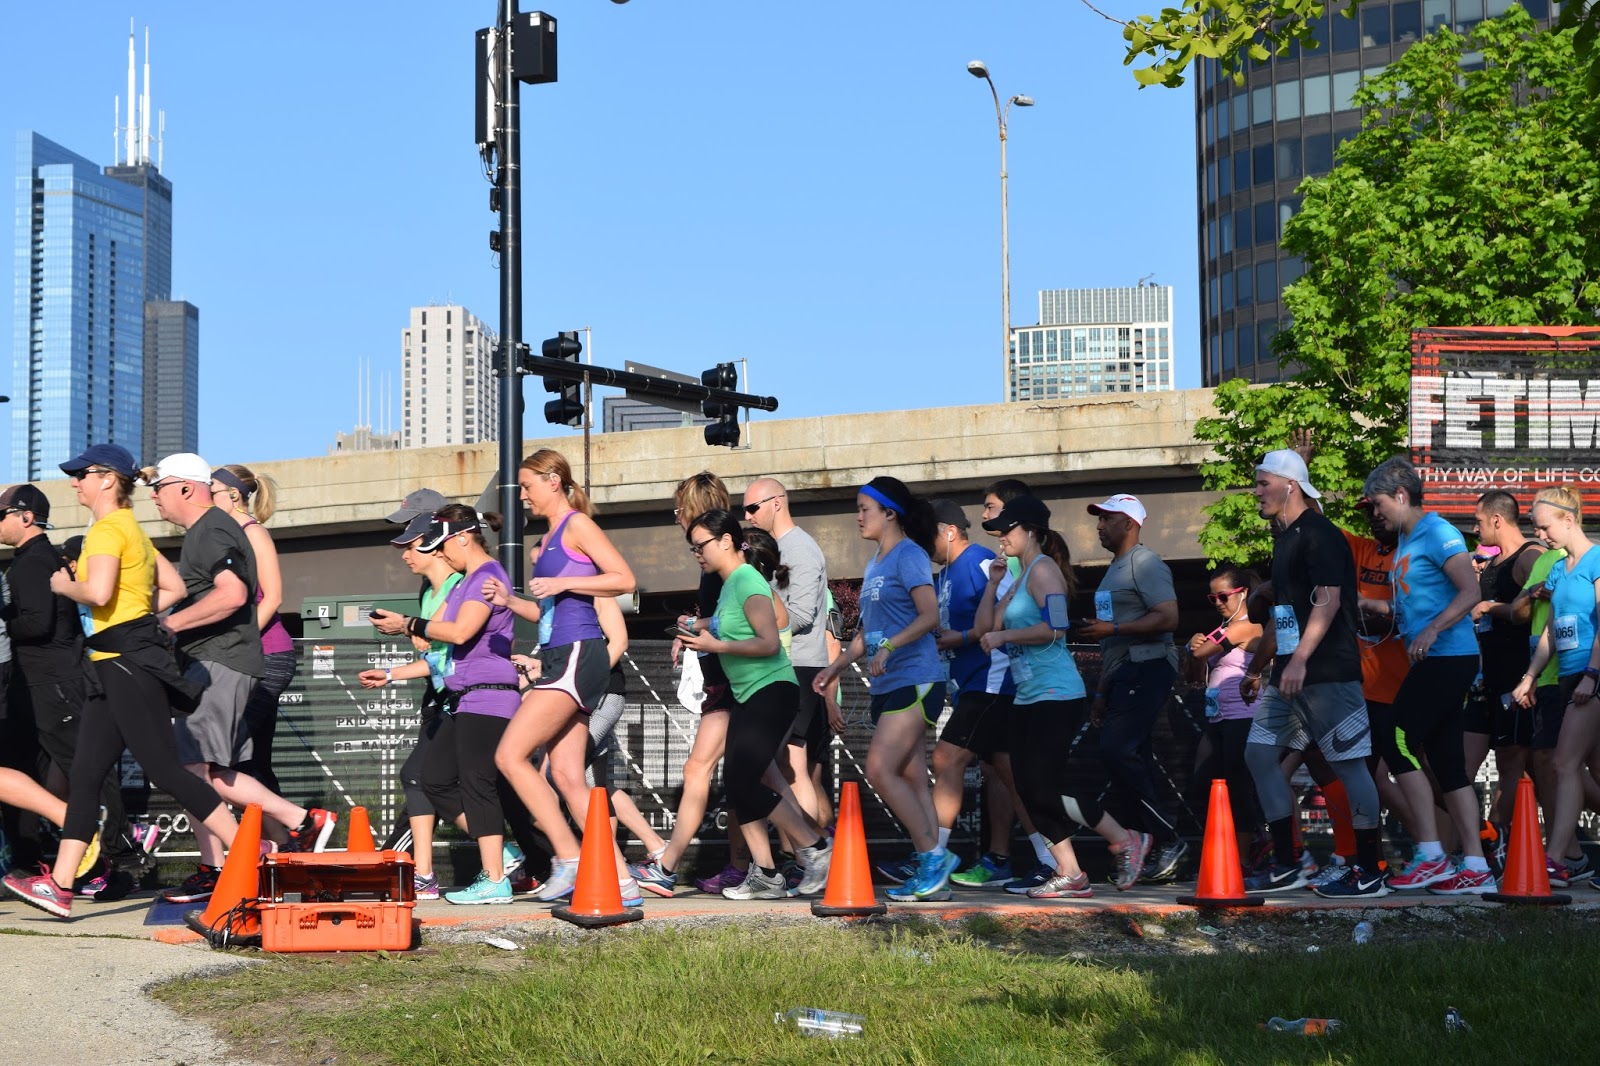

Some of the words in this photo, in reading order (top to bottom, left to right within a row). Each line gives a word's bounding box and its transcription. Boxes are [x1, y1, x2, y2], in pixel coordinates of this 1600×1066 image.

[1456, 467, 1499, 482] WAY
[1503, 467, 1530, 483] OF
[1534, 467, 1576, 483] LIFE
[320, 607, 327, 616] 7
[1275, 616, 1294, 630] 666
[338, 717, 354, 726] PK
[335, 742, 352, 751] PR
